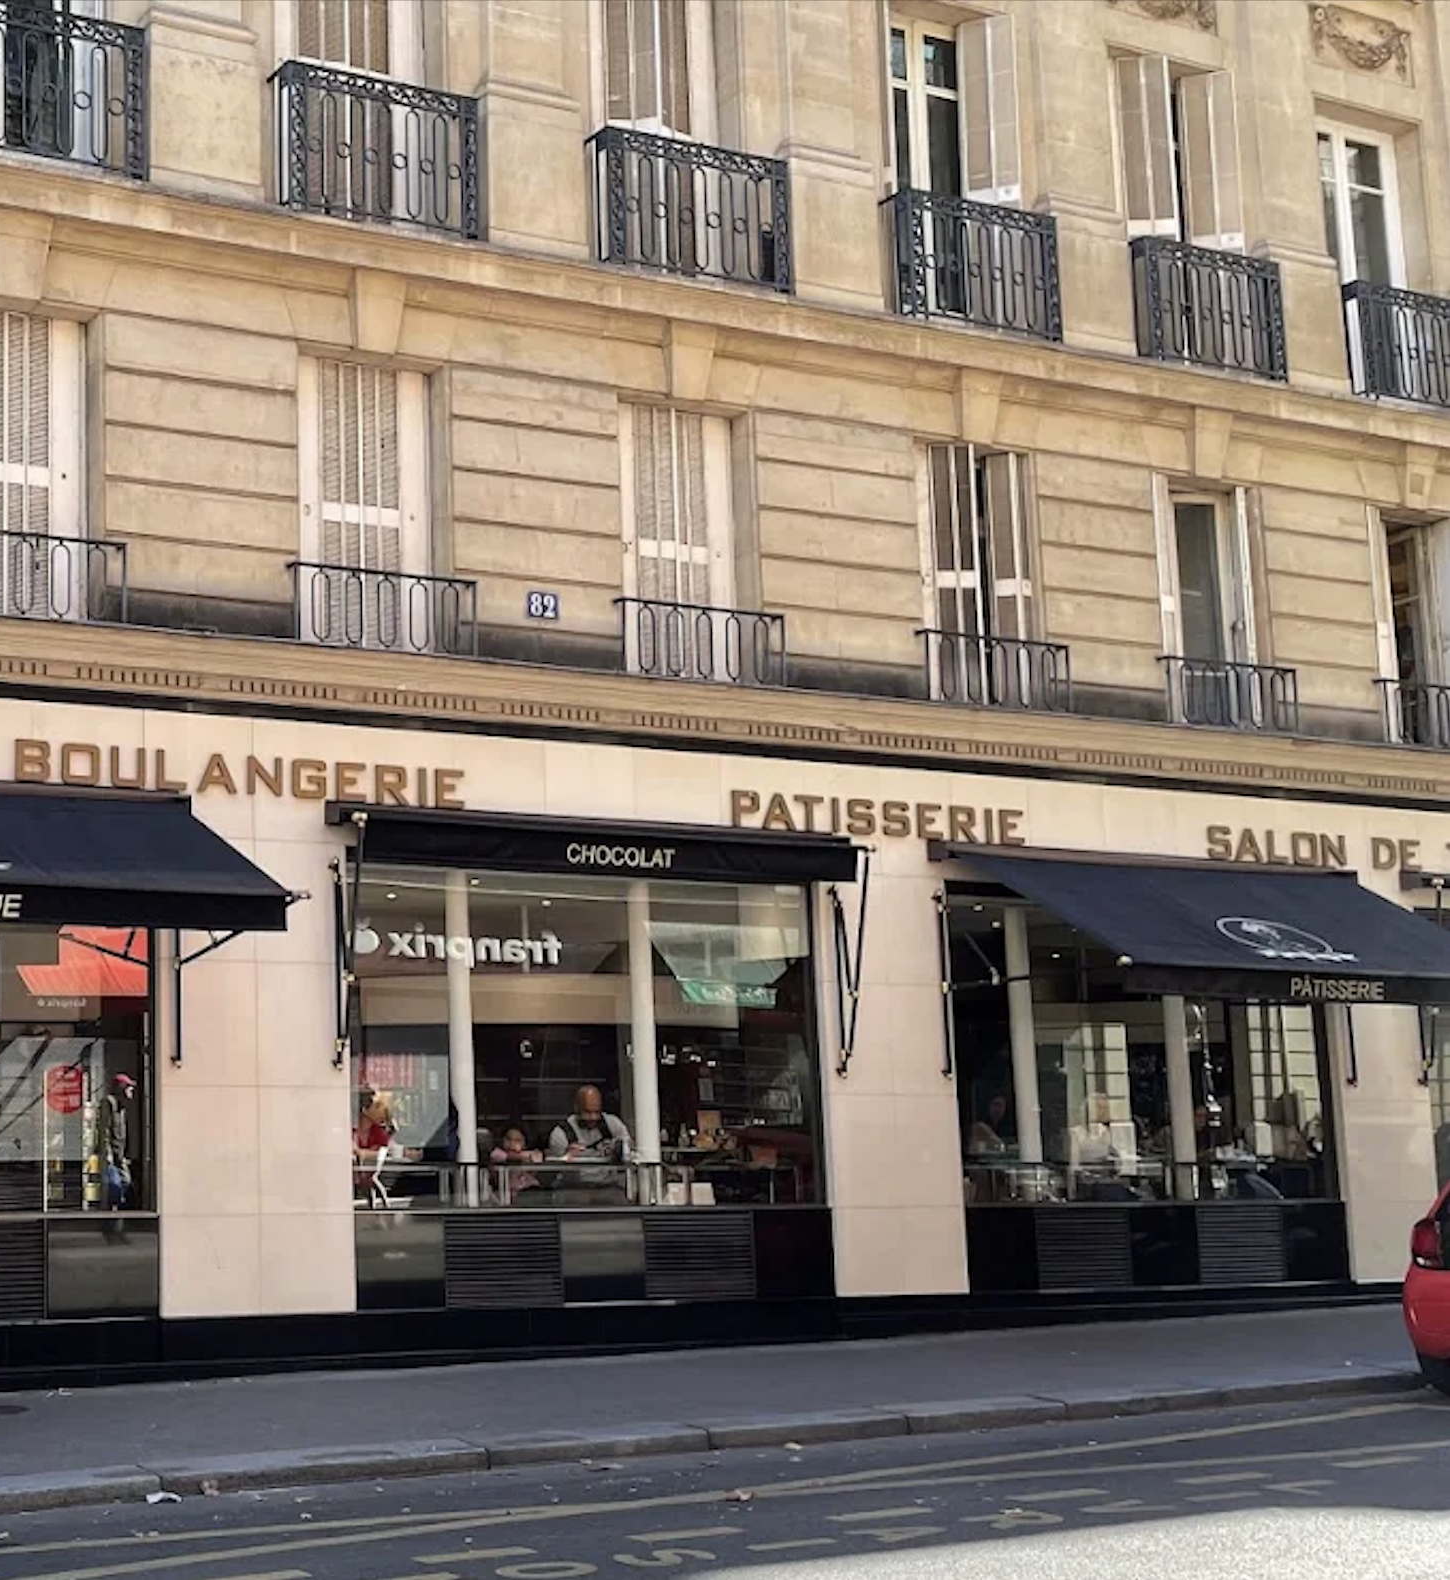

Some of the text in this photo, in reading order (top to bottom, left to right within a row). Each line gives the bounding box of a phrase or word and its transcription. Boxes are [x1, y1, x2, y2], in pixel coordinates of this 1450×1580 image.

[530, 593, 556, 617] 82
[11, 737, 467, 810] BOULANGERIE
[729, 789, 1027, 846] PATISSERIE
[565, 842, 677, 869] CHOCOLAT
[1206, 825, 1348, 867] SALON
[1370, 836, 1423, 872] DE
[1290, 973, 1386, 1000] PÂTISSERIE
